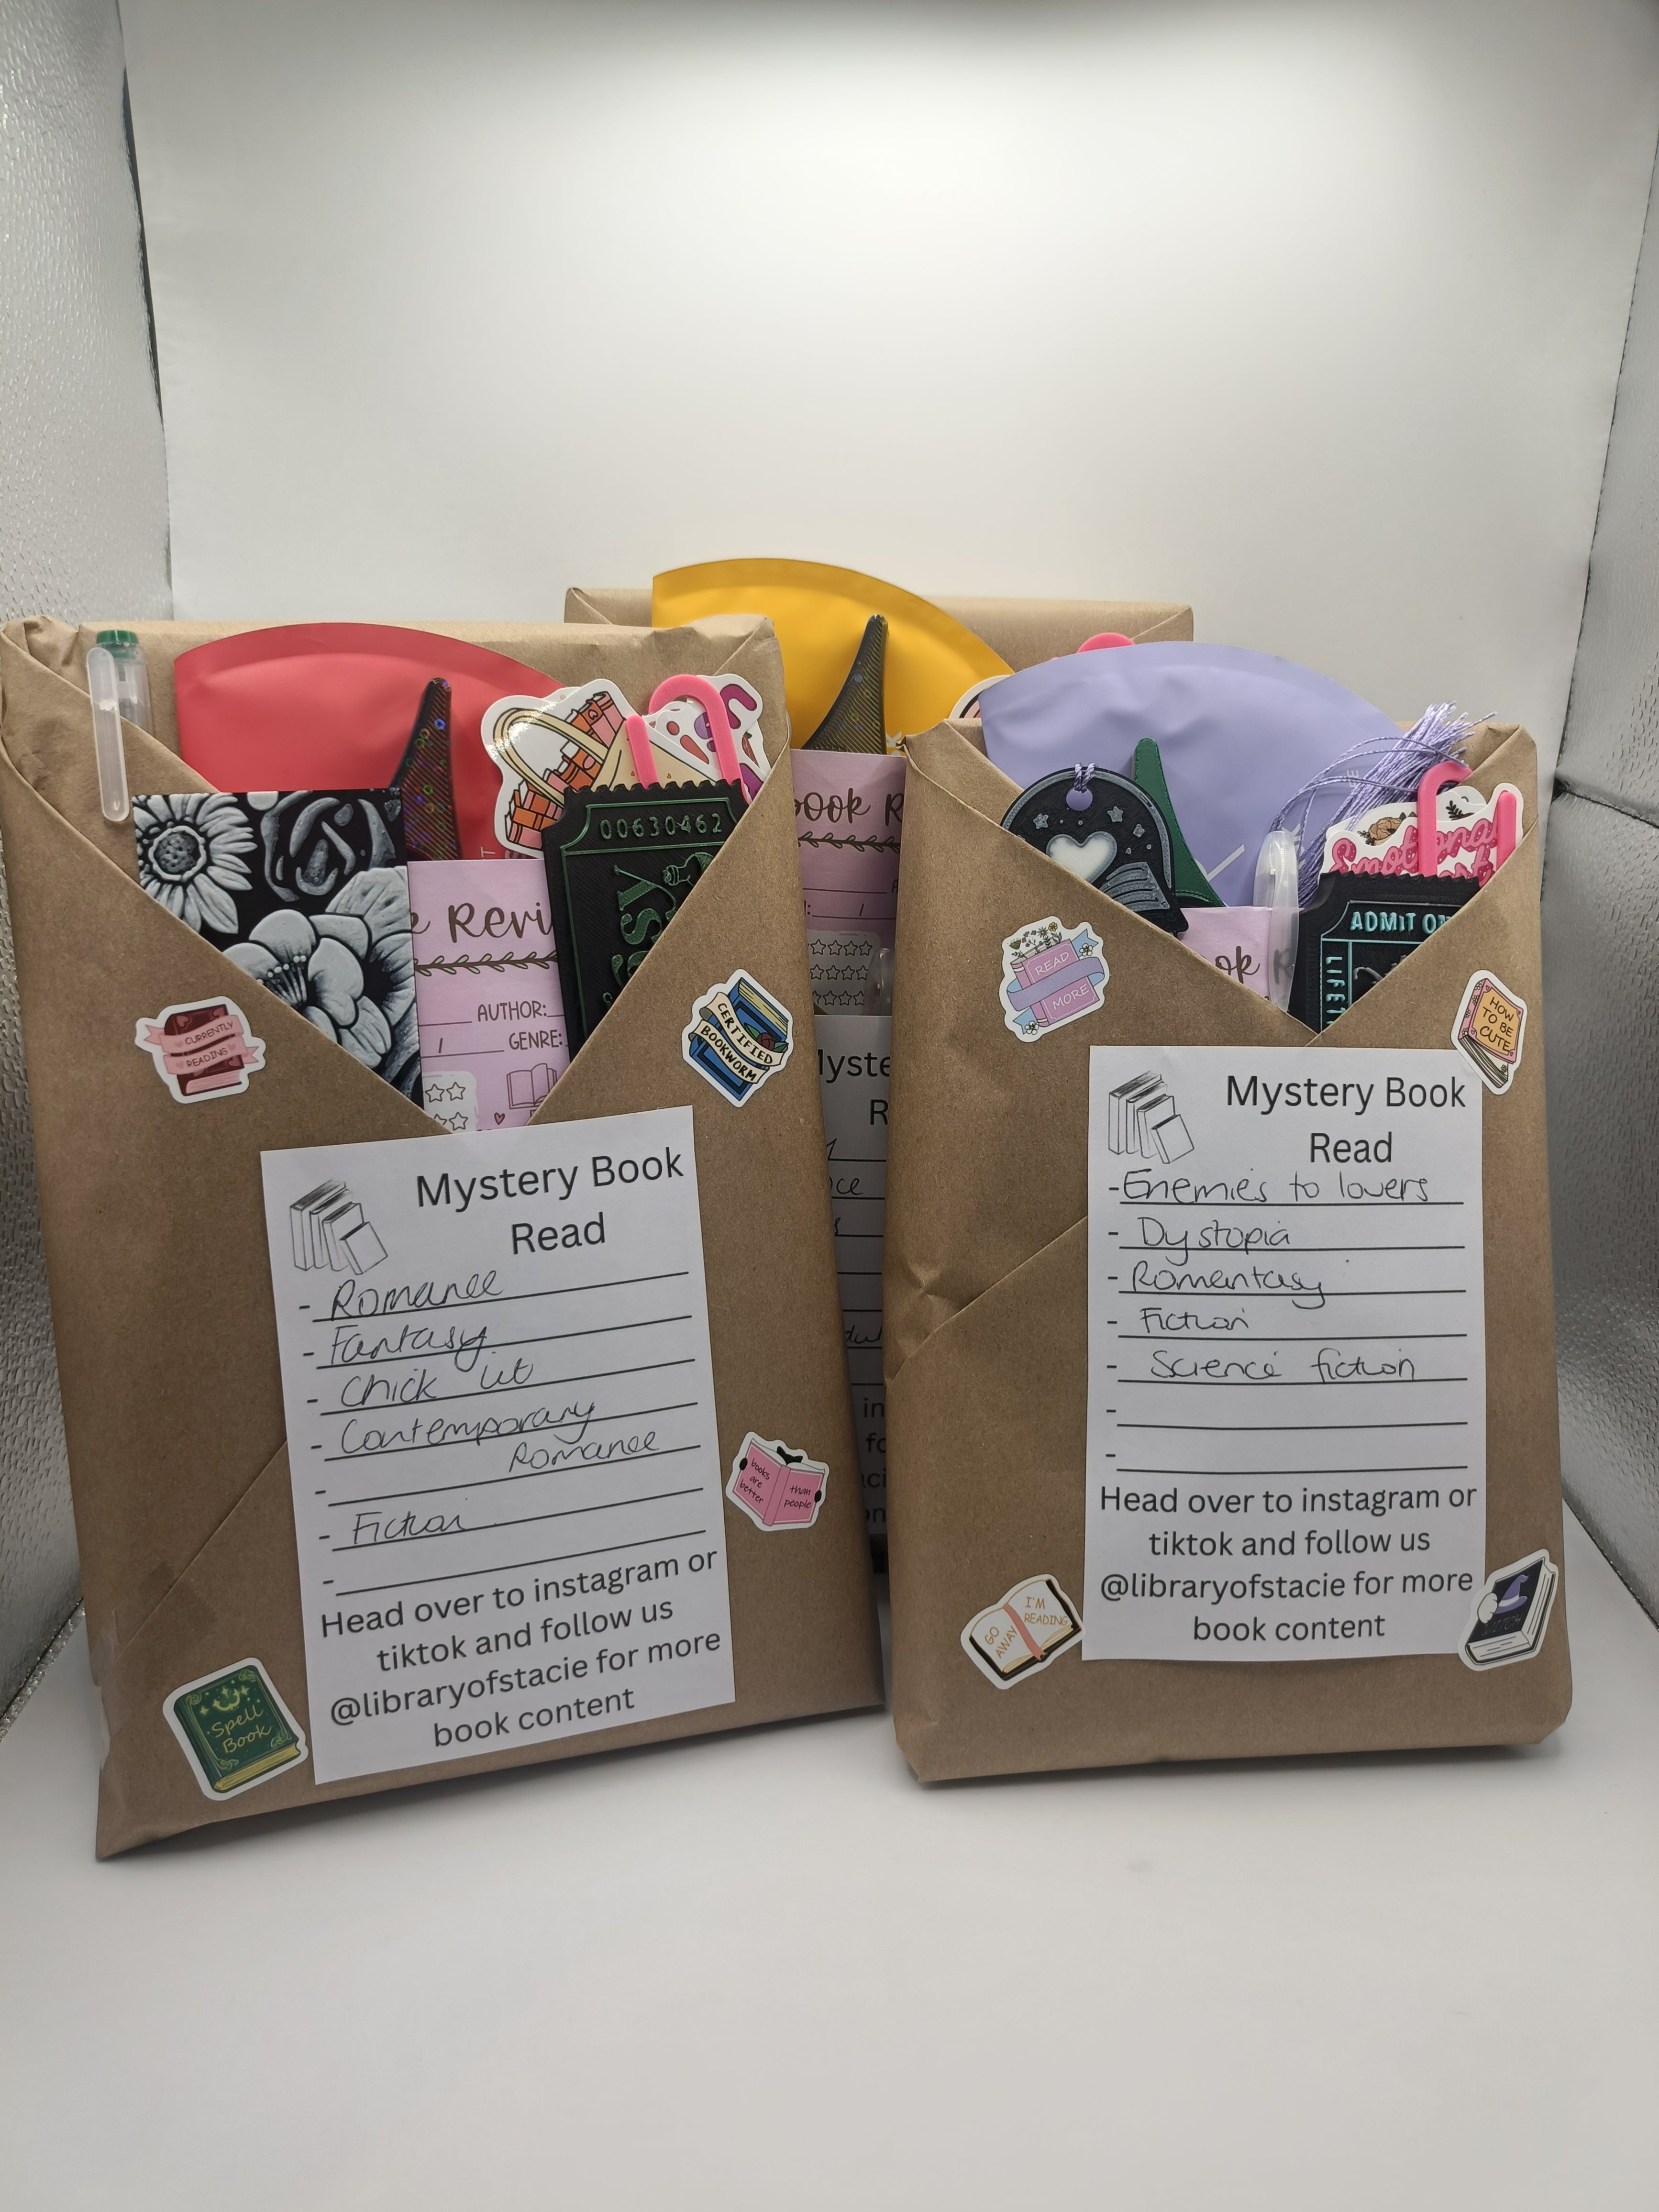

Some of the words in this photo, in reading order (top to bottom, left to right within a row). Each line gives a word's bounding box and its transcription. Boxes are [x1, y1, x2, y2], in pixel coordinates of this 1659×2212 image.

[600, 813, 723, 840] 00630462
[1349, 911, 1416, 932] ADMIT
[1034, 951, 1070, 976] READ
[1052, 983, 1090, 1010] MORE
[1489, 996, 1515, 1022] HOW
[477, 1001, 548, 1022] AUTHOR:
[1482, 1006, 1498, 1024] TO
[1499, 1022, 1514, 1038] BE
[185, 1021, 234, 1046] CURRENTLY
[509, 1029, 563, 1051] GENRE:
[717, 1003, 773, 1064] CERTIFIED
[1480, 1026, 1511, 1052] CUTE
[186, 1047, 229, 1068] READING
[700, 1025, 757, 1082] BOOKWORM
[1226, 1075, 1375, 1116] Mystery
[1385, 1076, 1466, 1108] Book
[1309, 1131, 1393, 1163] Read
[416, 1162, 579, 1213] Mystery
[591, 1147, 685, 1187] Book
[1123, 1168, 1268, 1204] Enemies
[1289, 1171, 1320, 1202] to
[1339, 1171, 1429, 1202] lovers
[510, 1211, 606, 1256] Read
[1137, 1217, 1291, 1266] Dystopia
[1139, 1306, 1249, 1334] Fiction
[330, 1324, 488, 1372] Fantasy
[1150, 1349, 1283, 1380] Science
[1311, 1347, 1416, 1383] fiction
[342, 1401, 596, 1454] Contemporary
[749, 1475, 763, 1488] are
[751, 1458, 770, 1480] books
[740, 1479, 764, 1504] better
[784, 1499, 812, 1510] people
[790, 1485, 811, 1496] than
[1100, 1486, 1178, 1513] Head
[1187, 1492, 1255, 1514] over
[1262, 1490, 1293, 1514] to
[1302, 1487, 1440, 1517] instagram
[1448, 1485, 1477, 1507] or
[354, 1510, 467, 1545] Fiction
[1149, 1530, 1234, 1557] tiktok
[1241, 1530, 1296, 1556] and
[1305, 1528, 1392, 1555] follow
[1399, 1531, 1431, 1552] us
[320, 1601, 405, 1638] Head
[414, 1592, 485, 1623] over
[492, 1586, 525, 1611] to
[533, 1557, 680, 1604] instagram
[687, 1548, 719, 1573] or
[1100, 1572, 1346, 1605] @libraryofstacie
[1353, 1570, 1394, 1596] for
[1402, 1572, 1473, 1594] more
[1025, 1596, 1045, 1609] I'M
[1024, 1613, 1068, 1626] READING
[1193, 1615, 1267, 1642] book
[1275, 1614, 1386, 1642] content
[376, 1634, 468, 1673] tiktok
[475, 1622, 532, 1657] and
[540, 1608, 634, 1644] follow
[641, 1598, 675, 1622] us
[984, 1626, 1000, 1645] GO
[994, 1625, 1018, 1659] AWAY
[330, 1656, 589, 1727] @libraryofstacie
[596, 1645, 640, 1676] for
[647, 1631, 722, 1665] more
[211, 1704, 264, 1738] Spell
[433, 1710, 511, 1748] book
[518, 1687, 635, 1732] content
[222, 1724, 272, 1753] Book
